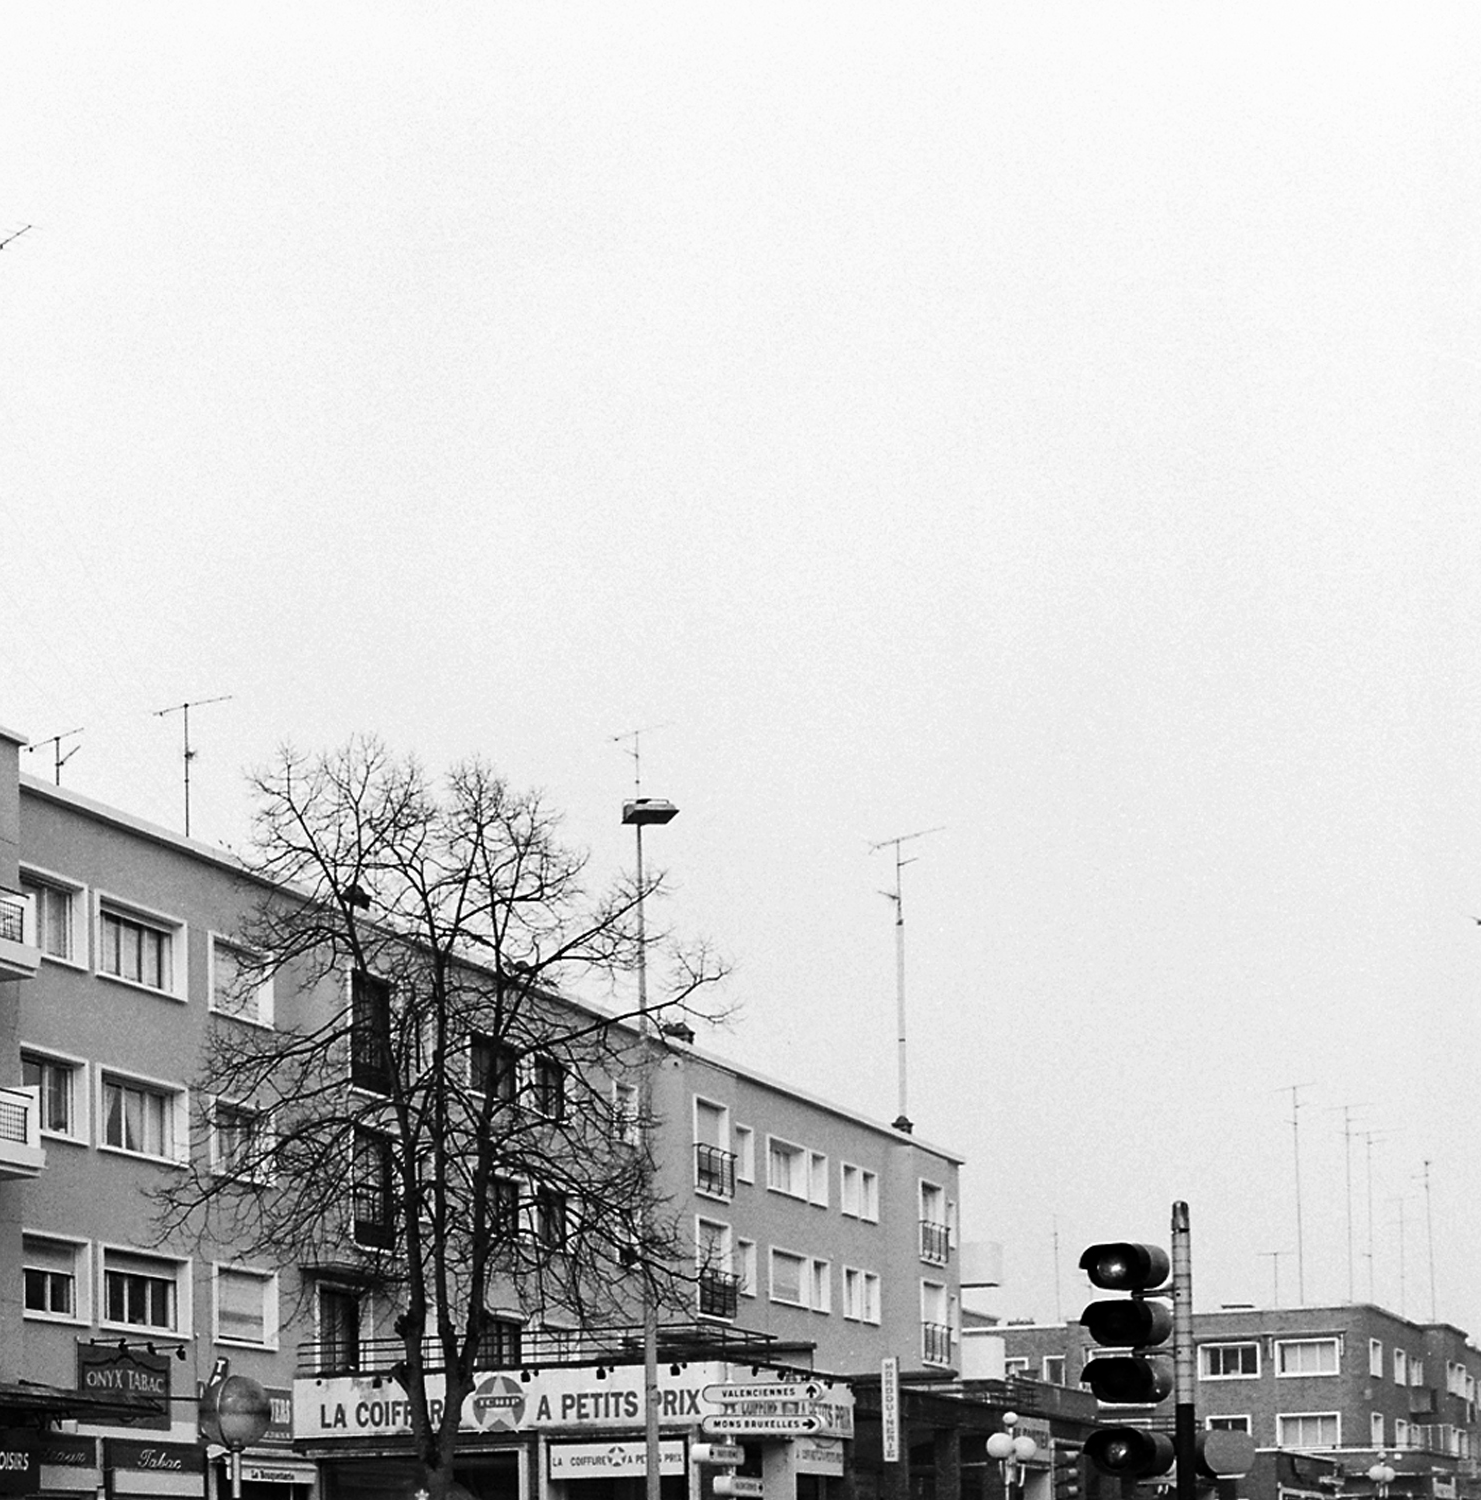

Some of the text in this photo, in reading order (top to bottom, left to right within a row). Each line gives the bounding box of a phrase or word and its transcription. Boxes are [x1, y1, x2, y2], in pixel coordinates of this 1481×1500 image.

[86, 1370, 165, 1394] ONYX TABAC
[721, 1388, 796, 1398] VALENCIENNES
[320, 1403, 347, 1429] LA
[536, 1394, 552, 1421] A
[561, 1390, 638, 1419] PETITS
[713, 1419, 800, 1429] MONS BRUXELLES
[137, 1449, 182, 1470] Tabac
[552, 1457, 563, 1467] LA
[570, 1455, 607, 1467] COIFFURE
[664, 1453, 682, 1463] PRIX
